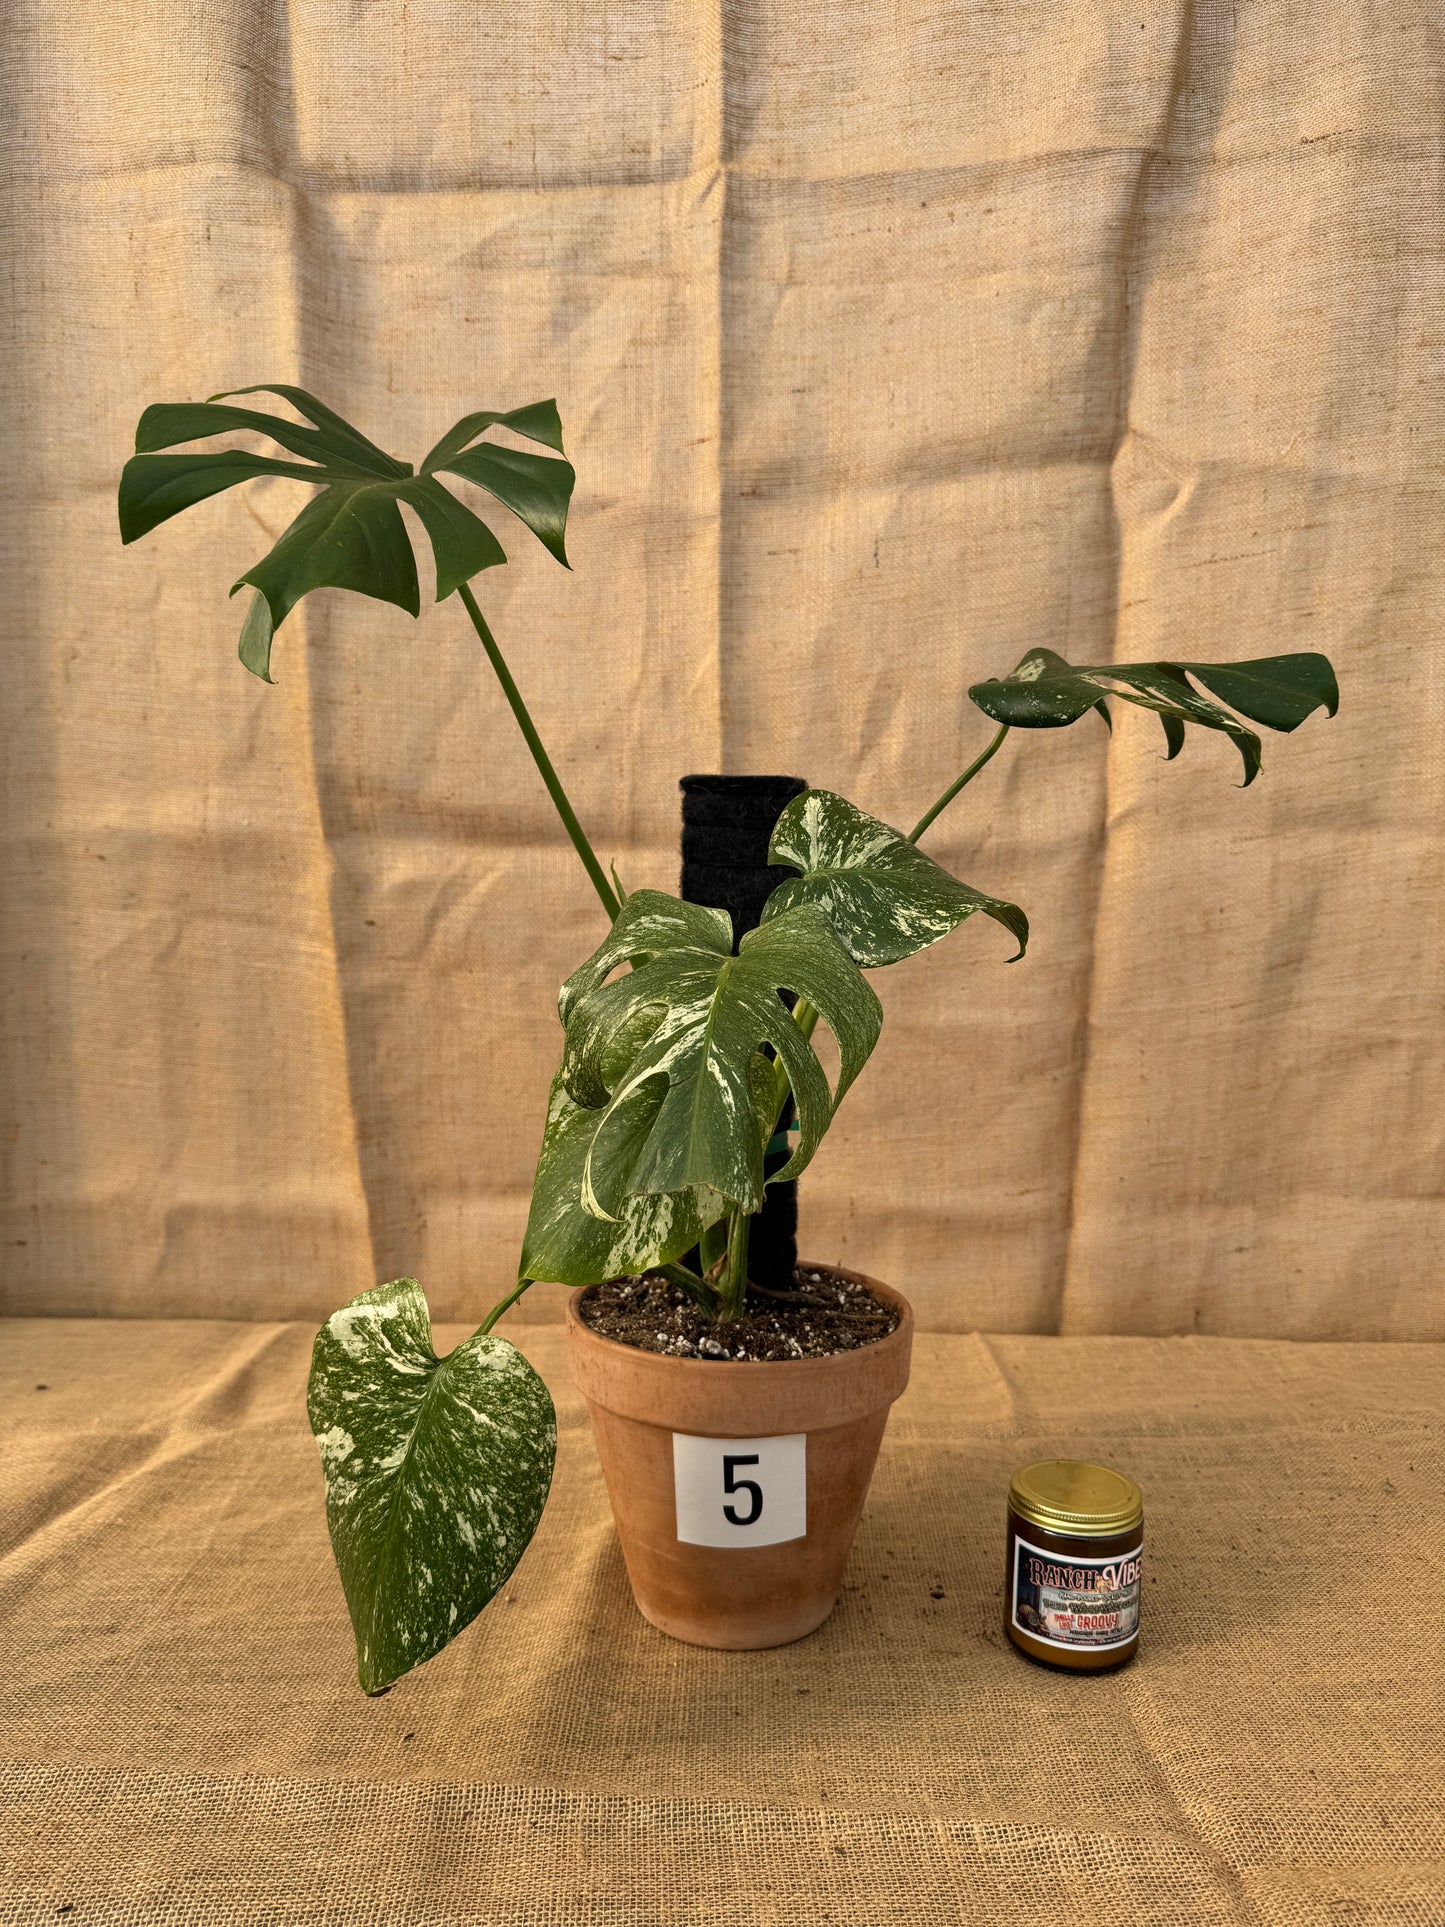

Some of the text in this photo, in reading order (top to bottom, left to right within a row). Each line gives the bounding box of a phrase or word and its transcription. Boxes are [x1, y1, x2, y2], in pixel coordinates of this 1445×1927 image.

[722, 1453, 764, 1526] 5
[1029, 1557, 1098, 1591] RANCH
[1076, 1613, 1120, 1630] GROOVY
